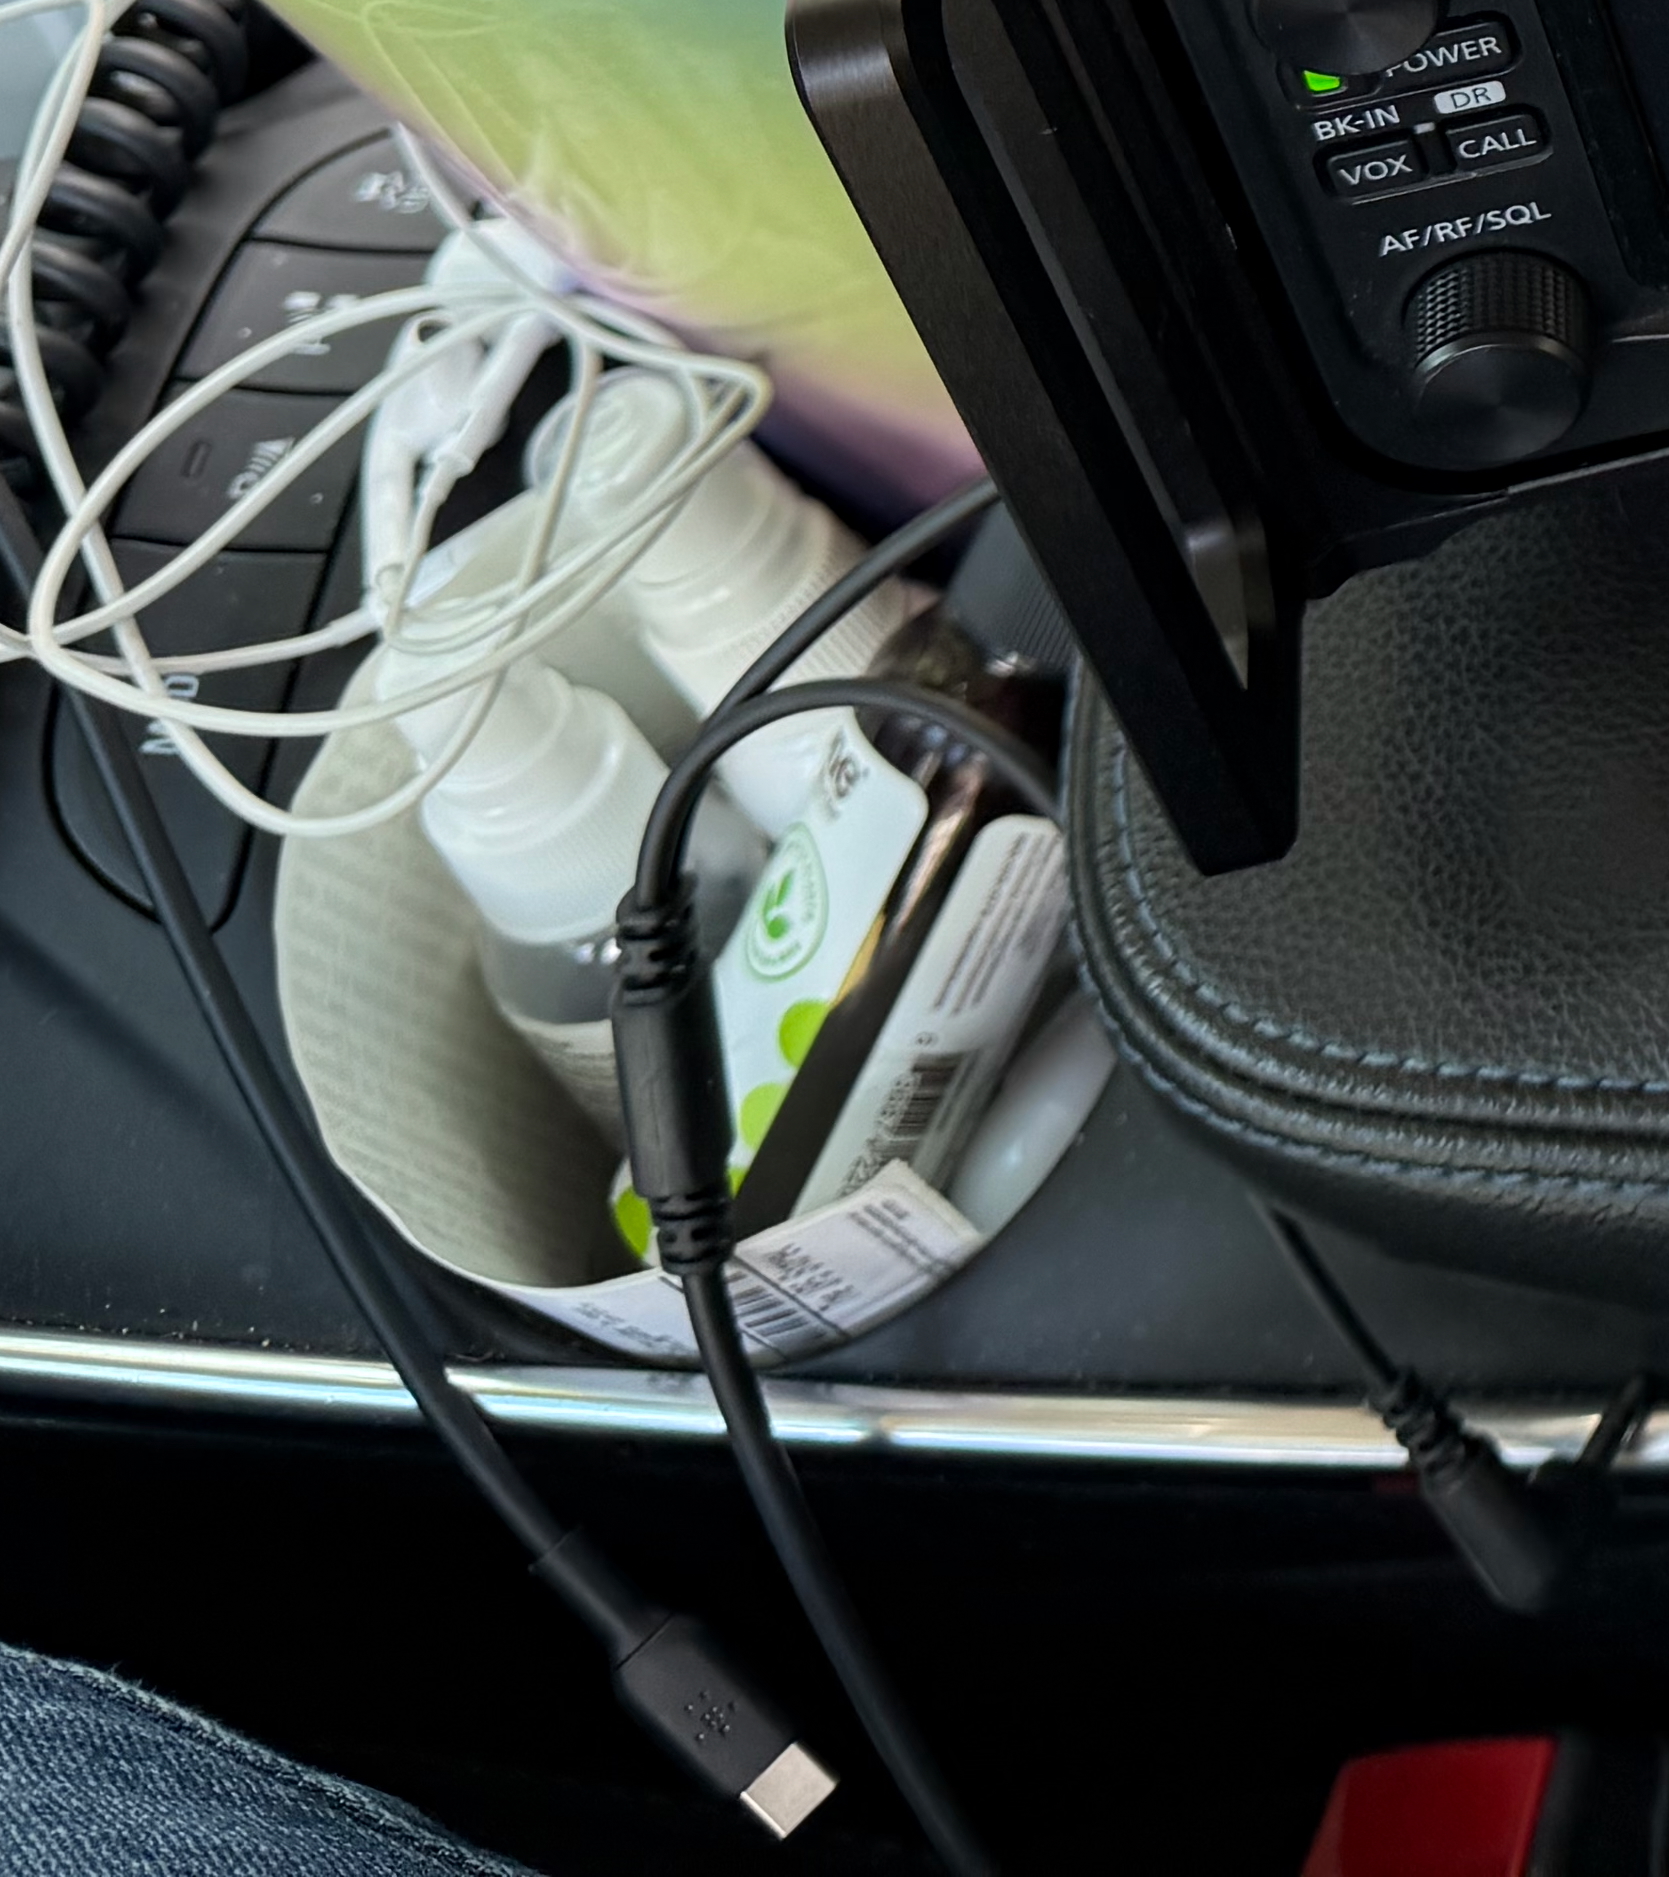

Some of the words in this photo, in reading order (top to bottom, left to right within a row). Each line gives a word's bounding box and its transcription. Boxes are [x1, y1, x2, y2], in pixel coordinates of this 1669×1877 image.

[1311, 104, 1402, 142] BK-IN
[1449, 84, 1491, 111] DR
[1338, 154, 1413, 187] VOX
[1458, 127, 1538, 161] CALL
[1377, 200, 1553, 258] AF/RF/SQL
